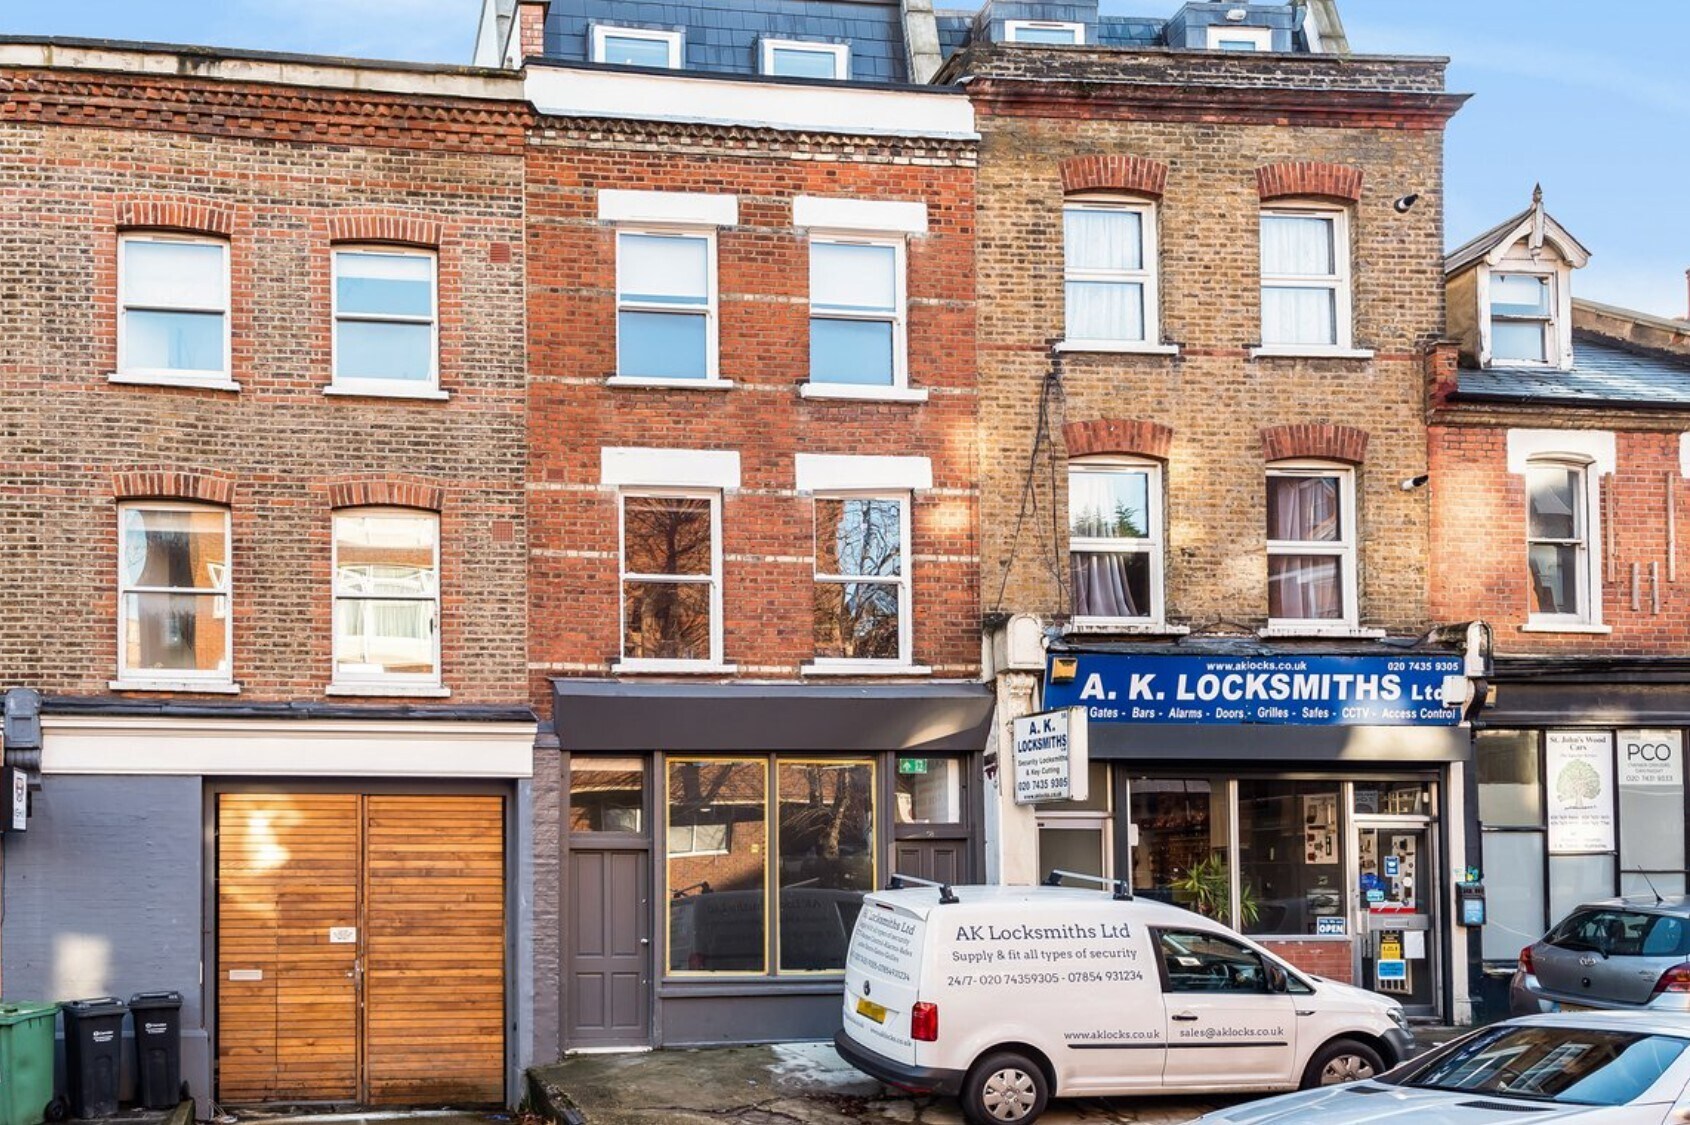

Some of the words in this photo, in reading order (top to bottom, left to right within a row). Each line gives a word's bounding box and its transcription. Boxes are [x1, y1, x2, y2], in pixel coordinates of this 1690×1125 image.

[1206, 661, 1306, 671] www.aklocks.co.uk
[1388, 662, 1405, 671] 020
[1409, 662, 1432, 671] 7435
[1435, 662, 1458, 671] 9305
[1080, 672, 1116, 700] A.
[1129, 673, 1165, 700] K.
[1176, 673, 1402, 700] LOCKSMITHS
[1090, 706, 1118, 718] Gates
[1132, 706, 1155, 718] Bars
[1168, 706, 1202, 718] Alarms
[1216, 706, 1244, 718] Doors
[1258, 706, 1289, 718] Grilles
[1302, 706, 1330, 718] Safes
[1342, 706, 1370, 718] CCTV
[1381, 706, 1416, 718] Access
[1420, 706, 1456, 718] Control
[1030, 722, 1040, 735] A.
[1044, 718, 1056, 732] K.
[1018, 734, 1067, 753] LOCKSMITHS
[1628, 744, 1671, 760] PCO
[1032, 779, 1048, 790] 7435
[1050, 777, 1068, 789] 9305
[901, 921, 916, 936] Ltd
[956, 926, 985, 942] AK
[988, 924, 1097, 940] Locksmiths
[1100, 922, 1132, 939] Ltd
[1319, 924, 1344, 933] OPEN
[952, 950, 993, 964] Supply
[996, 949, 1006, 960] &
[1008, 948, 1022, 960] fit
[1024, 948, 1038, 960] all
[1041, 949, 1072, 962] types
[1075, 948, 1087, 959] of
[1090, 948, 1137, 960] security
[980, 974, 1001, 985] 020
[1003, 972, 1059, 984] 74359305
[1068, 972, 1102, 983] 07854
[1105, 970, 1143, 982] 931234
[1064, 1029, 1160, 1039] www.aklocks.co.uk
[1180, 1027, 1284, 1039] sales@aklocks.co.uk
